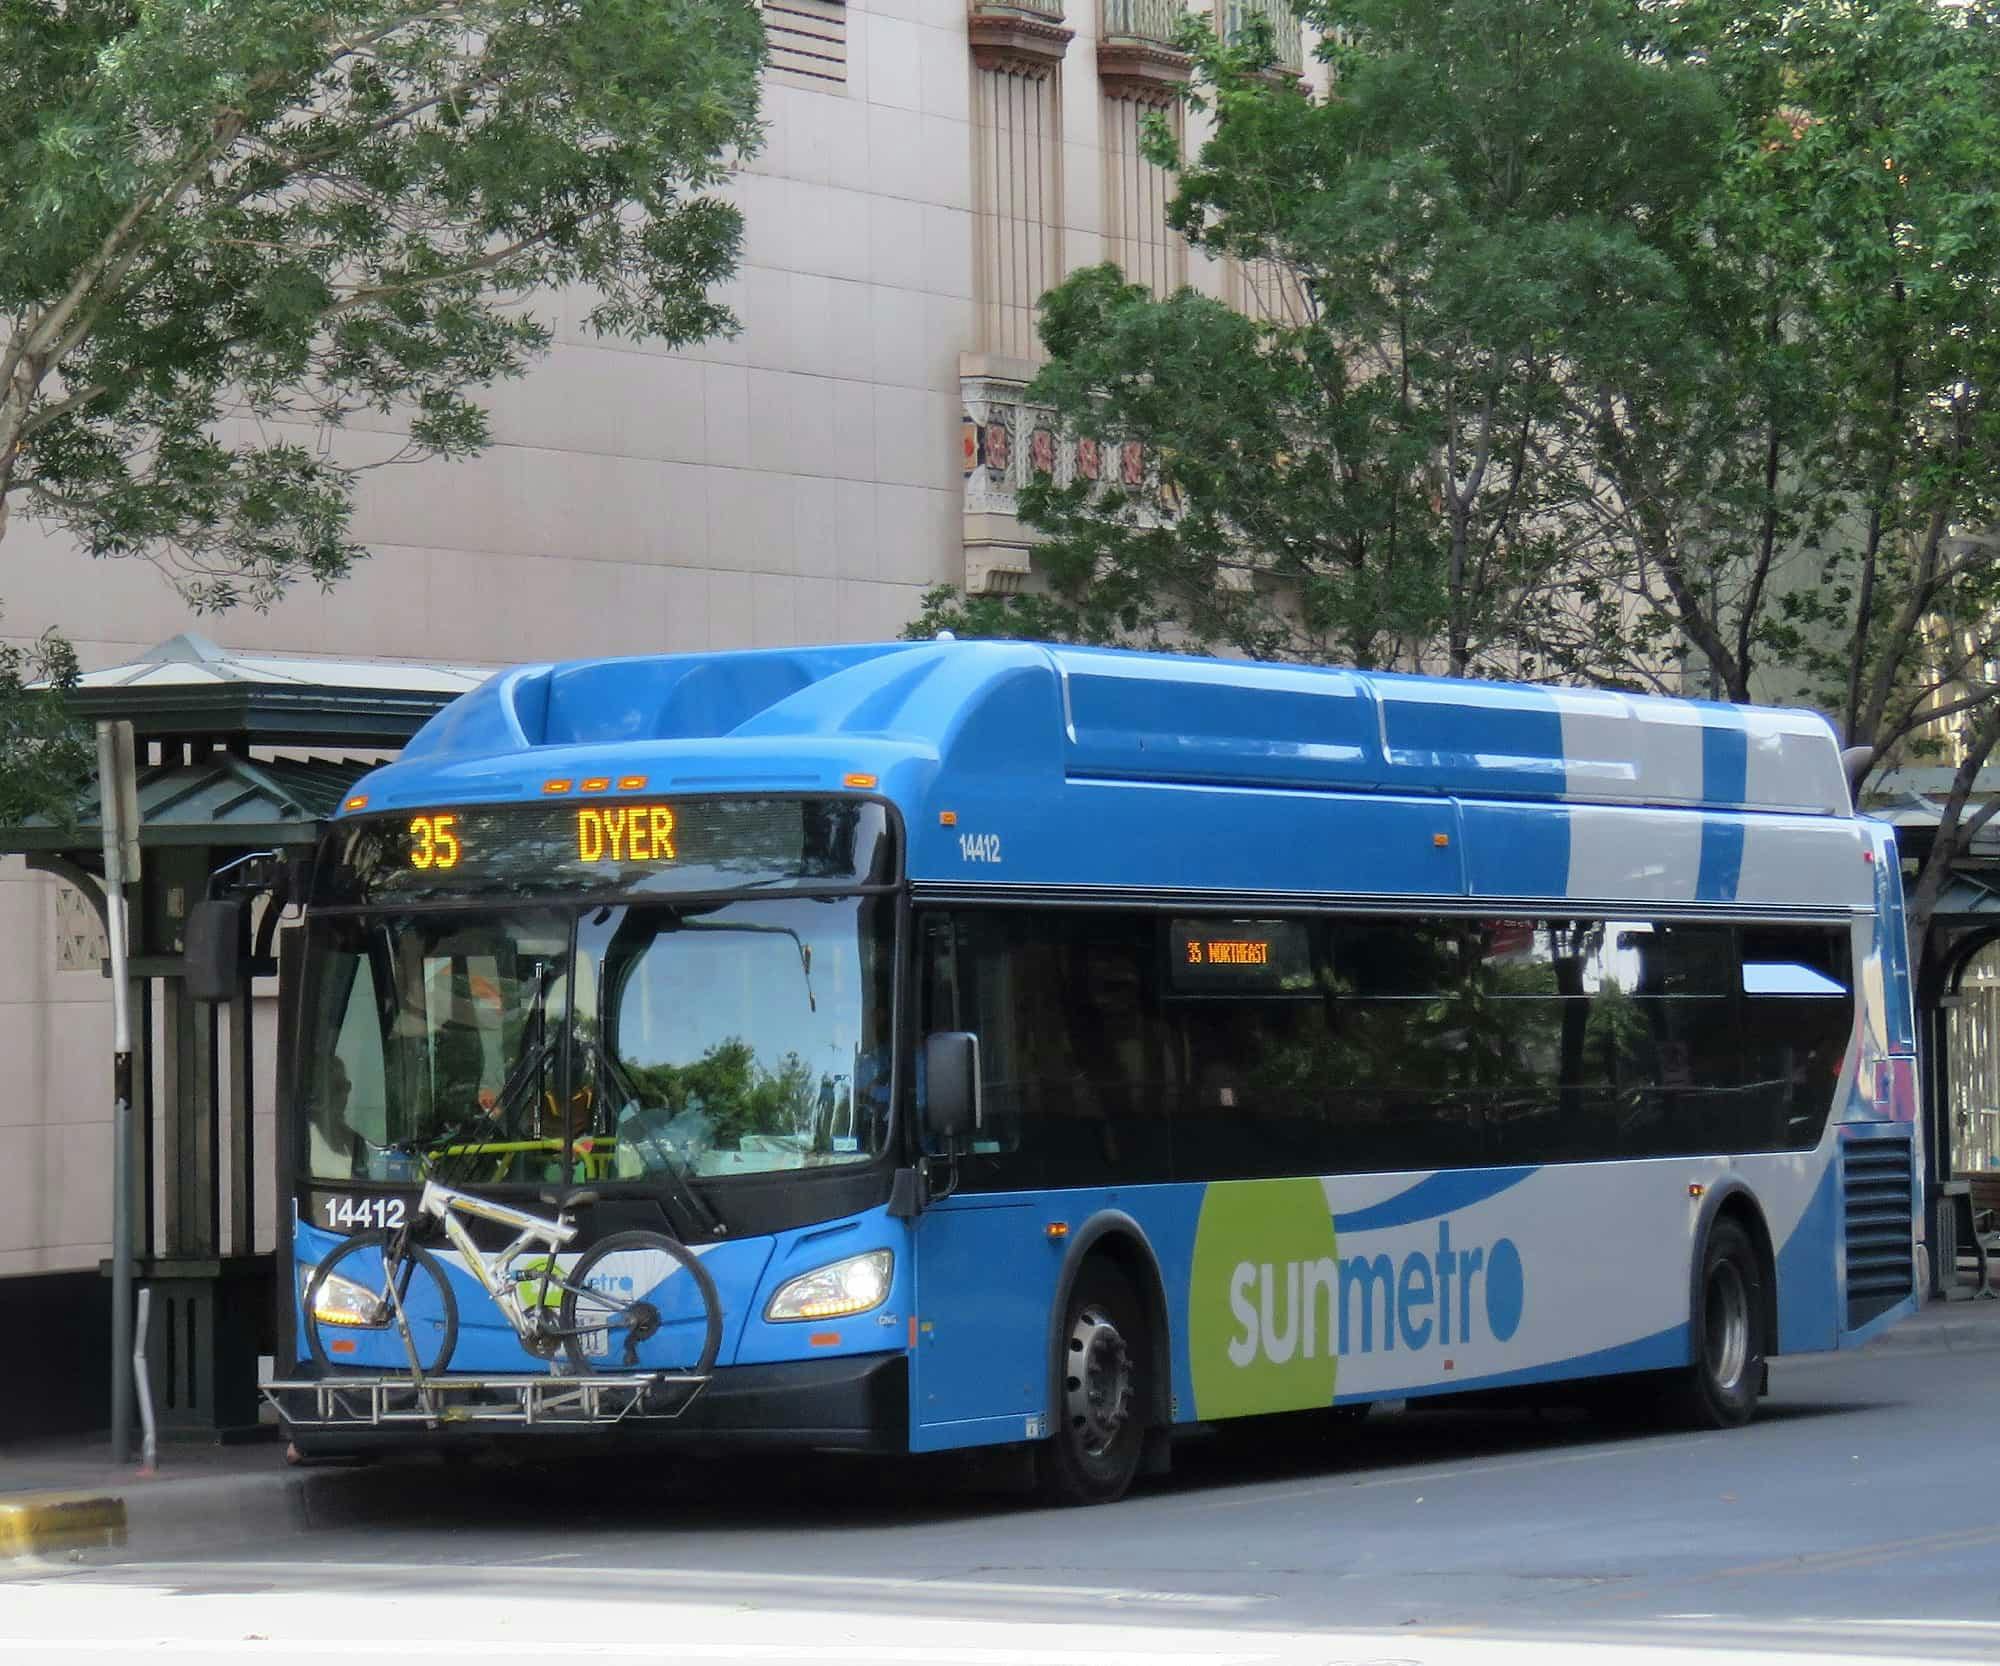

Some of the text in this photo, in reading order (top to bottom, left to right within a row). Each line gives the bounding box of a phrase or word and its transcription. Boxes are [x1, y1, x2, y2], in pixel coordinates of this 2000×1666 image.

[409, 807, 675, 869] 35 DYER
[959, 833, 1001, 862] 14412
[1187, 942, 1267, 963] 35 NORTHEAST
[324, 1198, 406, 1228] 14412
[1227, 1219, 1524, 1368] sunmetro
